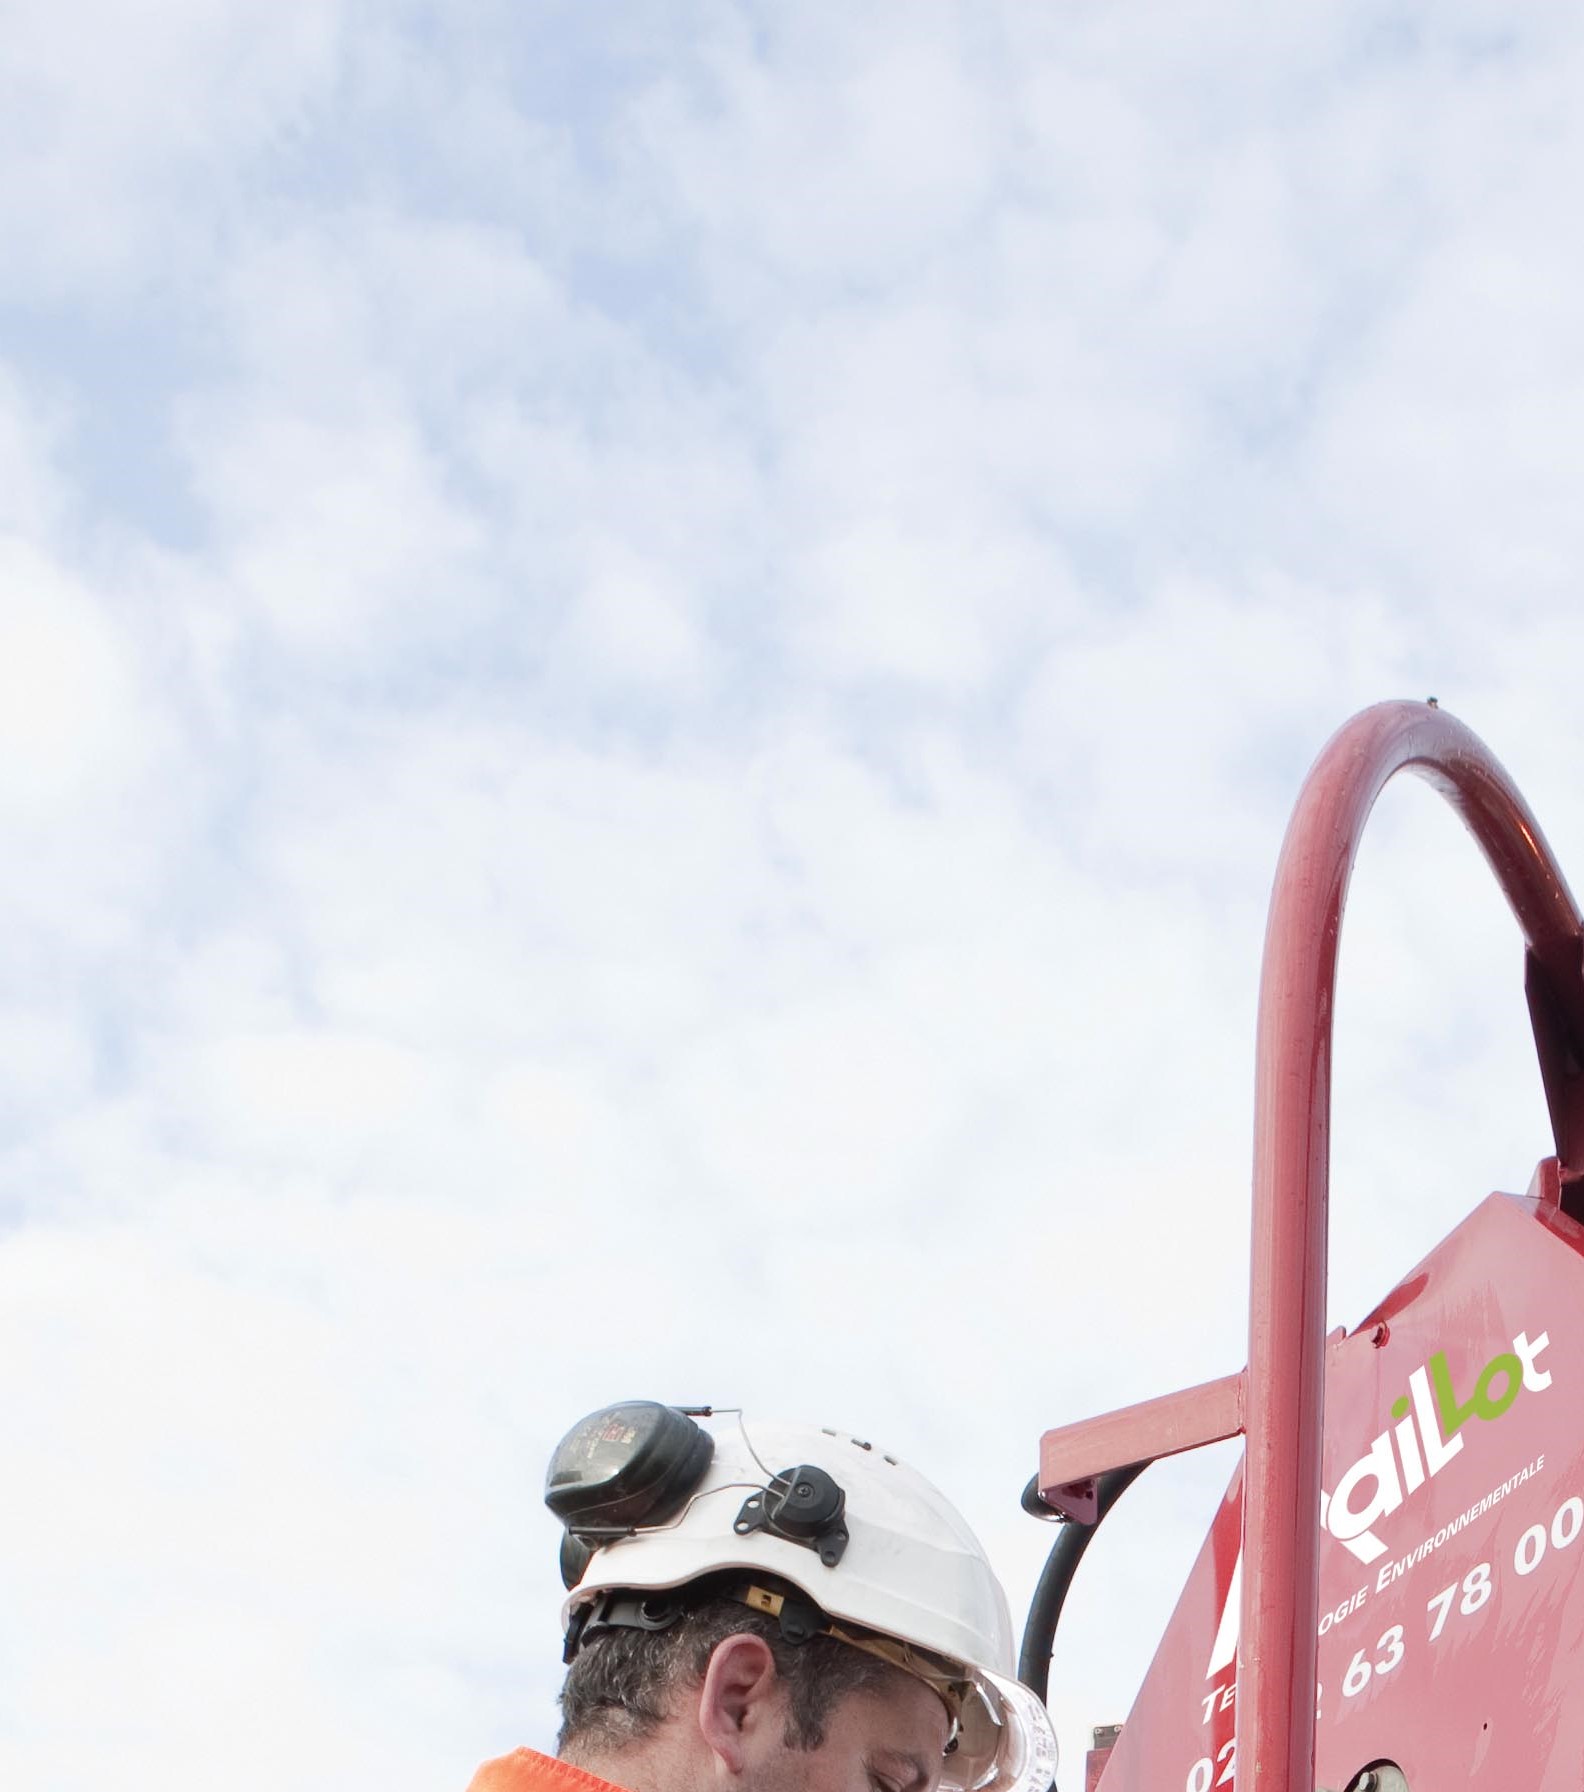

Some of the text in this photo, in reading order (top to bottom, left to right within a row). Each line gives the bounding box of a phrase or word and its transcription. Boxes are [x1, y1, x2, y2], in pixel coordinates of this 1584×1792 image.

[1341, 1624, 1405, 1698] 63
[1426, 1562, 1492, 1643] 78
[1513, 1496, 1584, 1576] 00
[1375, 1453, 1546, 1592] ENVIRONNEMENTALE
